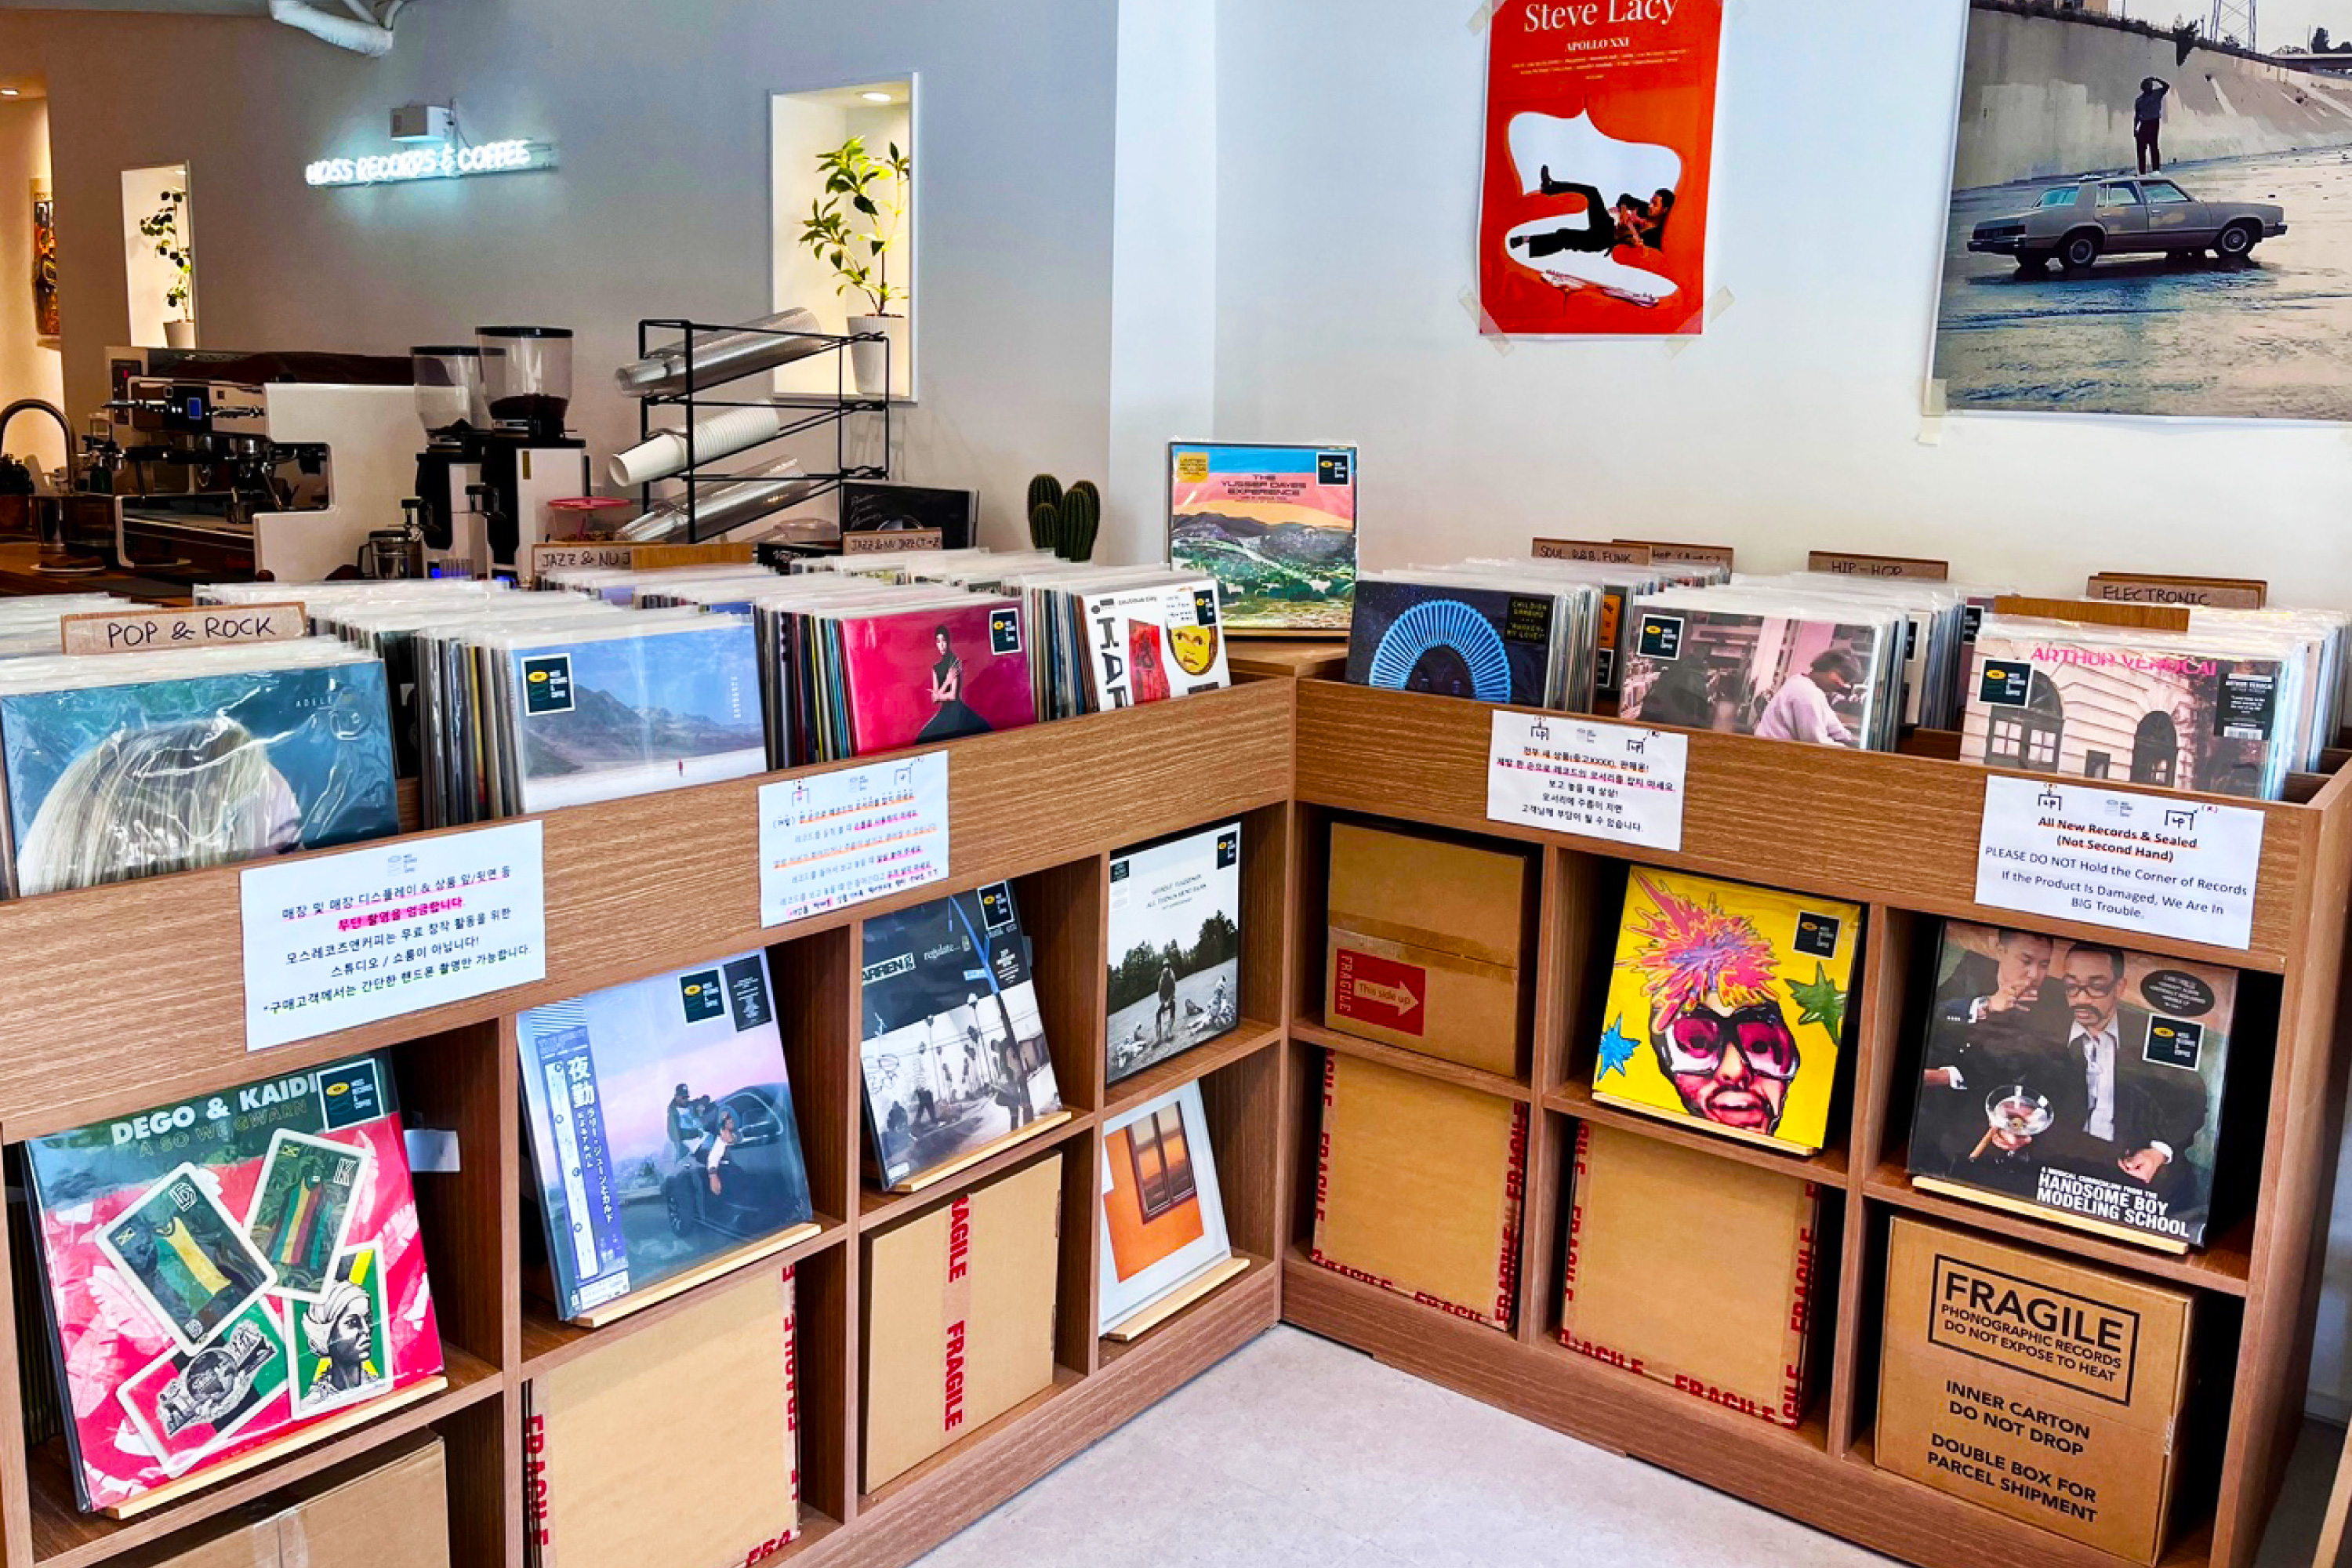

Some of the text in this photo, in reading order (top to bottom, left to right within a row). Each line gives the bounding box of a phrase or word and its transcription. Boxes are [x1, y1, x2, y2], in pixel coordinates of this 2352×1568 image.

[1525, 0, 1677, 32] Steve Lacy
[1566, 37, 1630, 52] APOLLO XXI
[356, 150, 437, 182] RECORDS
[458, 140, 531, 171] COFFEE
[542, 553, 576, 568] JAZZ
[581, 550, 594, 565] &
[2103, 585, 2211, 606] ELECTRONIC
[107, 616, 276, 648] POP & ROCK
[2030, 647, 2117, 670] ARTHUR
[2038, 816, 2198, 848] All New Records & Sealed
[2057, 834, 2174, 862] (Not Second Hand)
[1985, 846, 2248, 896] PLEASE DO NOT Hold the Corner of Records
[281, 903, 307, 921] 매장
[329, 895, 354, 913] 매장
[358, 882, 416, 906] 디스플레이
[2002, 870, 2224, 916] If the Product Is Damaged, We Are In
[2071, 897, 2144, 919] BIG Trouble.
[331, 956, 378, 978] 스튜디오
[1339, 955, 1353, 1011] FRAGILE
[1359, 983, 1410, 1005] This side up
[111, 1105, 195, 1146] DEGO
[205, 1097, 230, 1120] &
[239, 1073, 318, 1112] KAIDI
[160, 1132, 190, 1152] SO
[2037, 1188, 2190, 1238] MODELING SCHOOL
[2038, 1174, 2169, 1216] HANDSOME BOY
[1944, 1270, 2124, 1354] FRAGILE
[1941, 1303, 2122, 1370] PHONOGRAPHIC RECORDS
[1944, 1319, 2116, 1384] DO NOT EXPOSE TO HEAT
[945, 1320, 965, 1432] FRAGILE
[1946, 1379, 2091, 1440] INNER CARTON
[1949, 1399, 2084, 1457] DO NOT DROP
[1927, 1450, 2098, 1523] PARCEL SHIPMENT
[1931, 1432, 2097, 1504] DOUBLE BOX FOR
